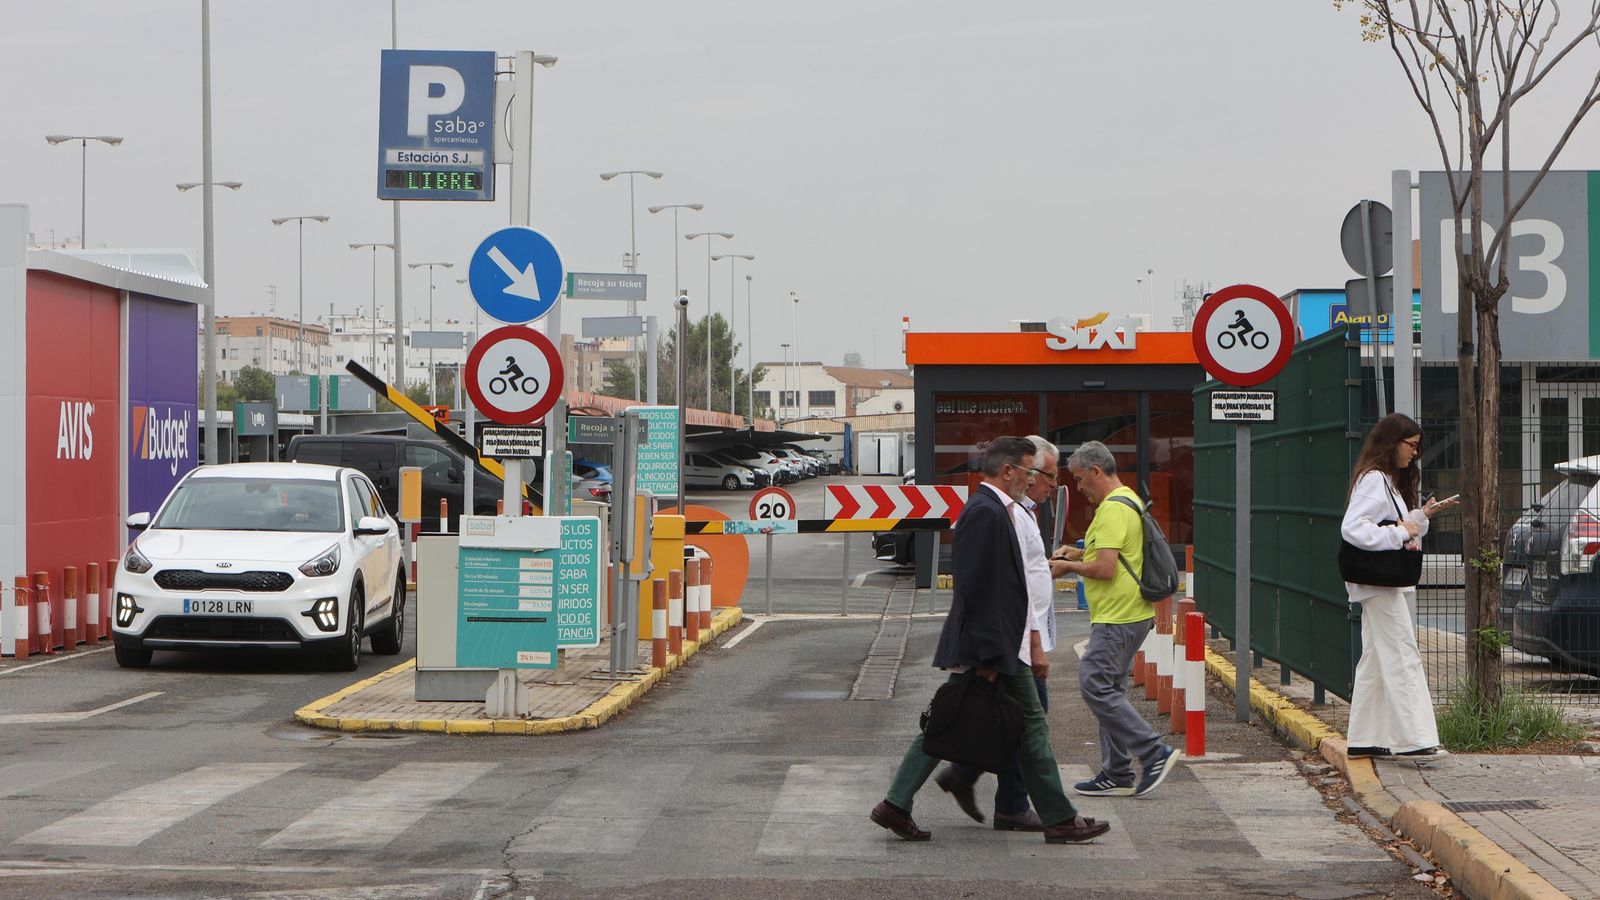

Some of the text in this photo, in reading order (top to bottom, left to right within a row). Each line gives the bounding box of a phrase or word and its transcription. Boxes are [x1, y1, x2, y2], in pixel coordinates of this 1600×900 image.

[407, 65, 465, 136] P
[434, 136, 478, 144] aparcamientos
[397, 151, 472, 164] Estación S.J.
[408, 172, 475, 190] LIBRE
[578, 279, 605, 288] Recoja
[619, 280, 643, 288] ticket
[661, 412, 675, 420] LOS
[56, 401, 94, 461] AVIS
[581, 423, 608, 433] Recoja
[149, 407, 189, 477] Budget
[652, 442, 673, 450] SABA
[661, 452, 675, 460] SER
[642, 482, 678, 490] ESTANCIA
[759, 502, 786, 519] 20
[571, 525, 591, 535] LOS
[560, 569, 588, 580] SABA
[571, 583, 589, 594] SER
[192, 600, 252, 613] 0128 LRN
[578, 612, 591, 624] DE
[558, 627, 594, 638] TANCIA
